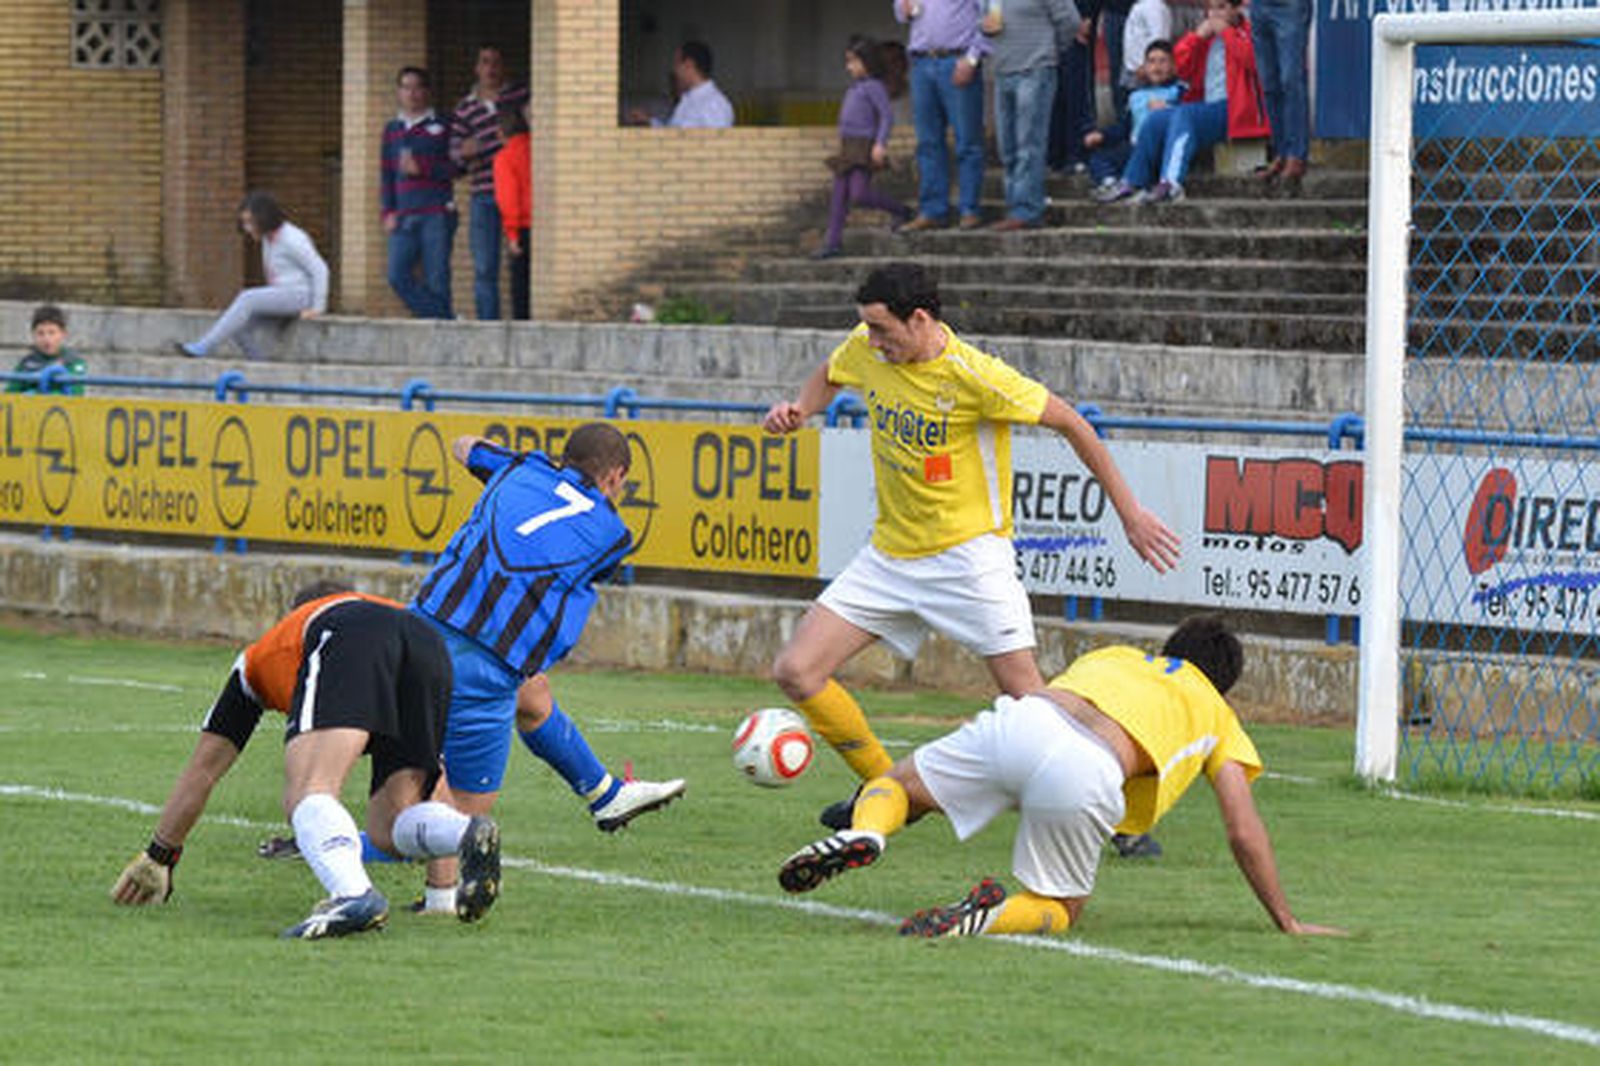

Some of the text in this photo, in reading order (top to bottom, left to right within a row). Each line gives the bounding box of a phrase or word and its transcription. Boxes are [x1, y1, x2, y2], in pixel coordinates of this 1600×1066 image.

[1413, 53, 1597, 103] nstrucciones
[105, 406, 198, 467] OPEL
[285, 414, 388, 479] OPEL
[691, 431, 812, 502] OPEL
[103, 476, 198, 523] Colchero
[285, 487, 388, 536] Colchero
[515, 480, 596, 536] 7
[1011, 471, 1106, 523] RECO
[1482, 493, 1600, 552] DIREC
[691, 512, 812, 565] Colchero
[1202, 536, 1307, 555] motos
[1030, 552, 1061, 584] 477
[1065, 555, 1089, 585] 44
[1093, 556, 1117, 588] 56
[1203, 566, 1242, 598] Tel.:
[1247, 569, 1271, 600] 95
[1276, 571, 1313, 602] 477
[1318, 573, 1342, 605] 57
[1524, 584, 1550, 618] 95
[1553, 584, 1591, 621] 477
